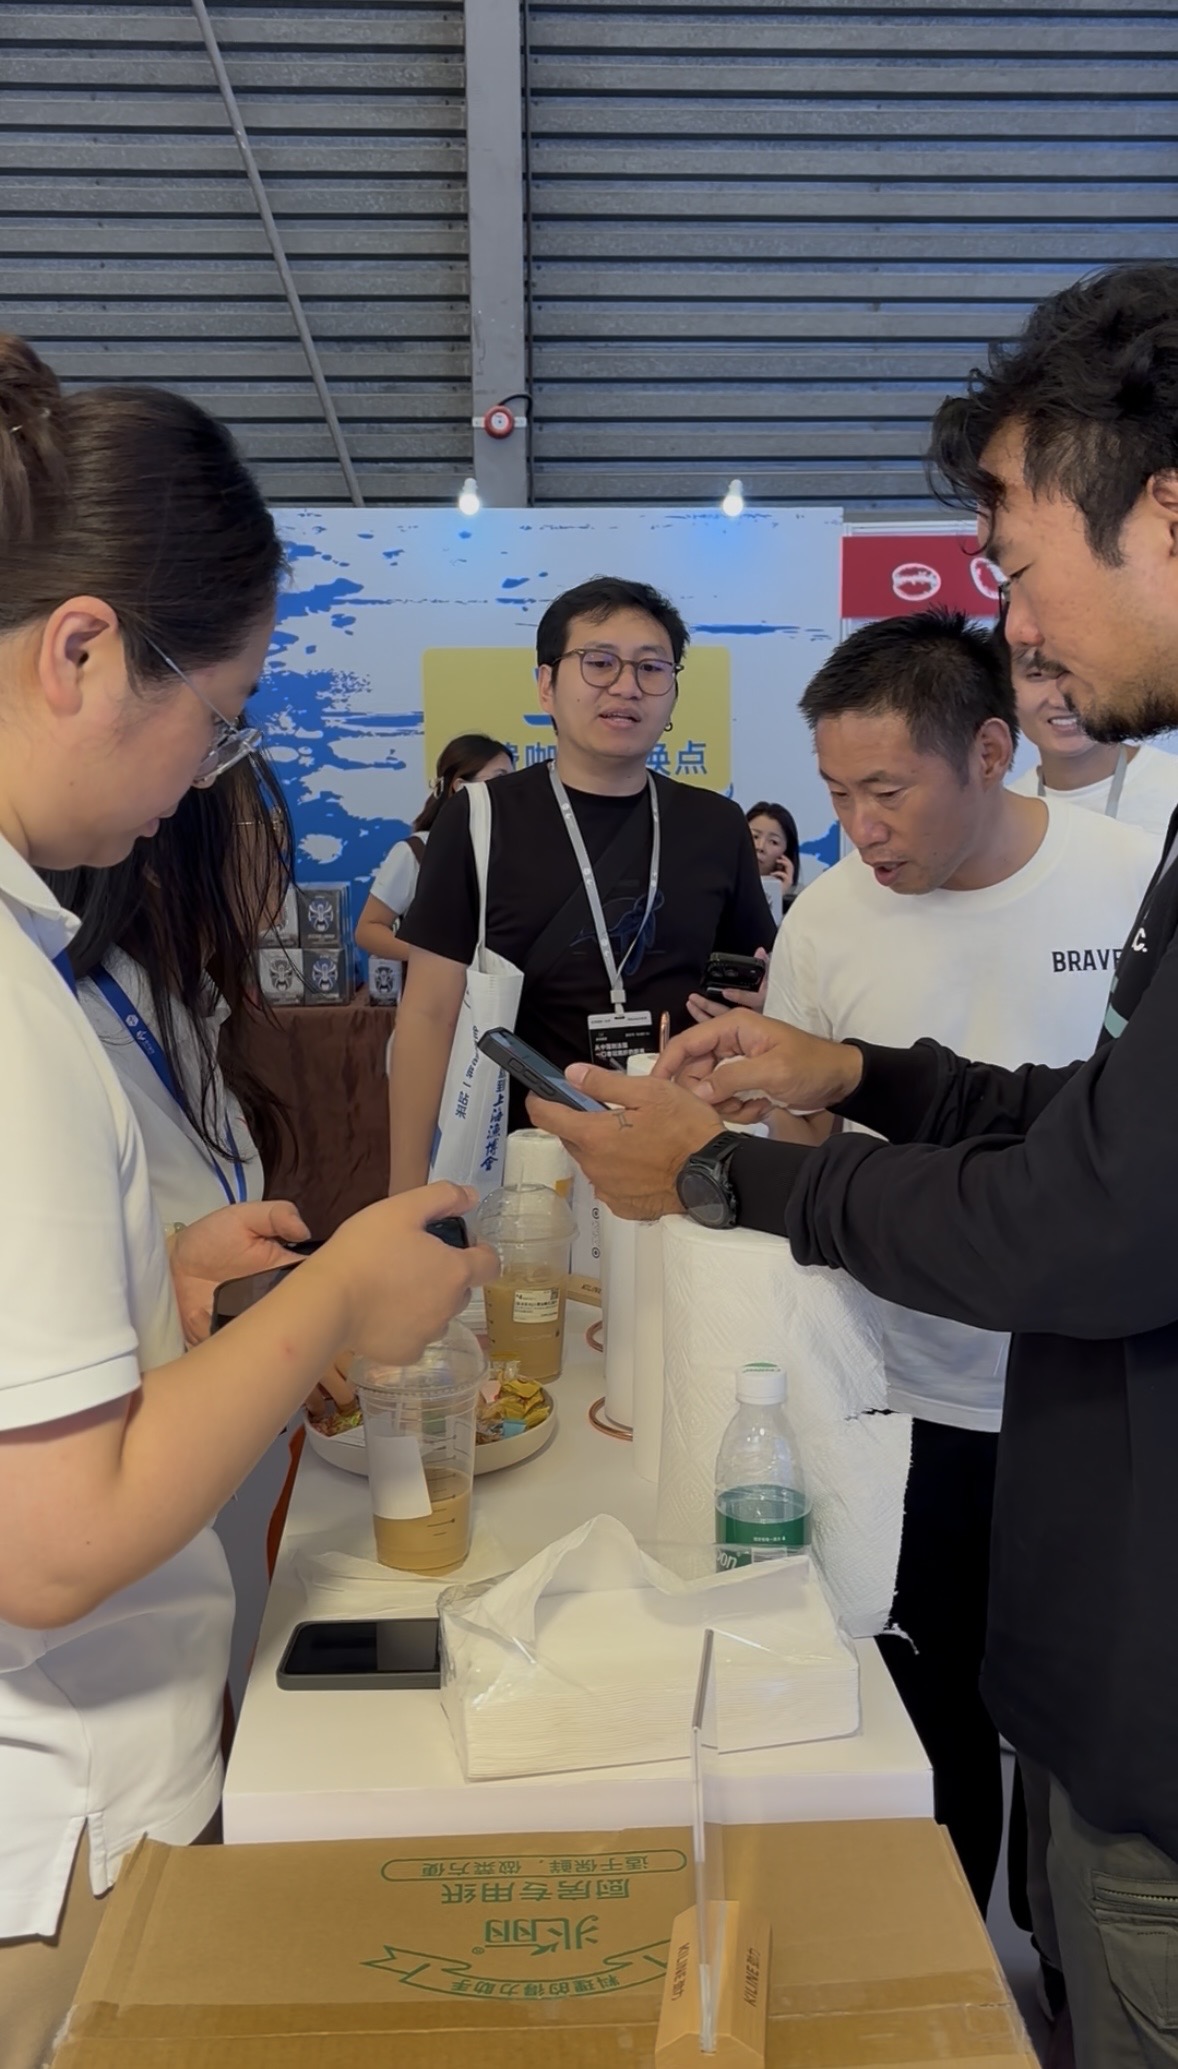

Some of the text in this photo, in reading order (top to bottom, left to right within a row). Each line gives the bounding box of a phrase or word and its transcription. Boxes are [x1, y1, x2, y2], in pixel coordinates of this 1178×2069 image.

[441, 1878, 630, 1904] 厨房专用纸
[449, 1974, 620, 1997] 料理的得力助手
